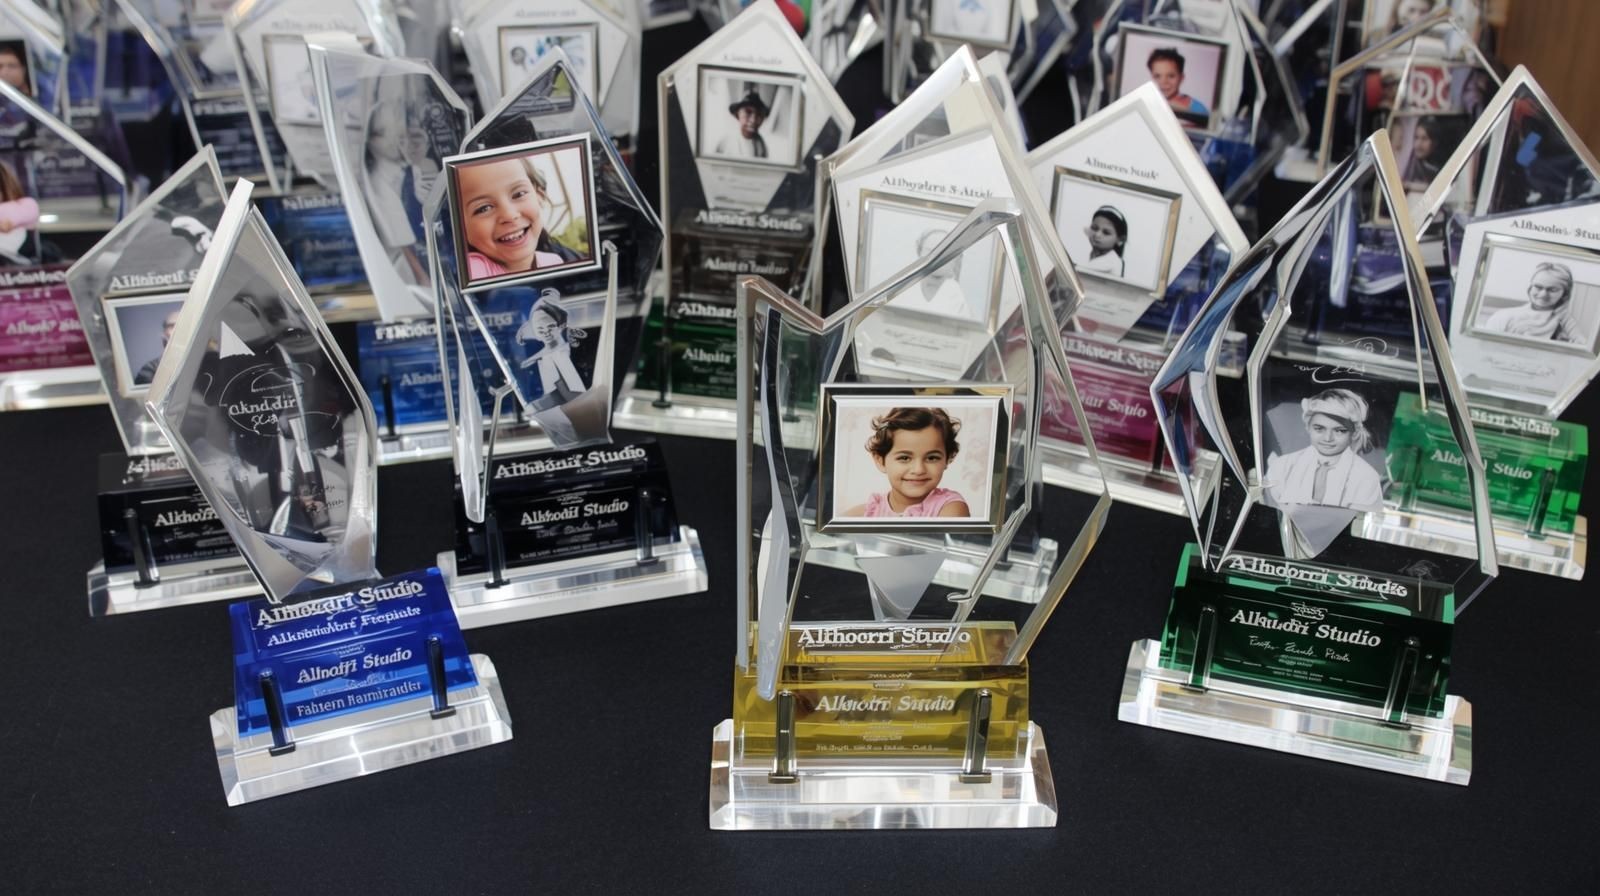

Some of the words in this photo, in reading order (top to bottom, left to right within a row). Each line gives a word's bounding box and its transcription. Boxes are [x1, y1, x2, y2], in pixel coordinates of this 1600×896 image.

[587, 444, 646, 466] Studio
[358, 579, 423, 604] Studio
[1315, 624, 1382, 647] Studio
